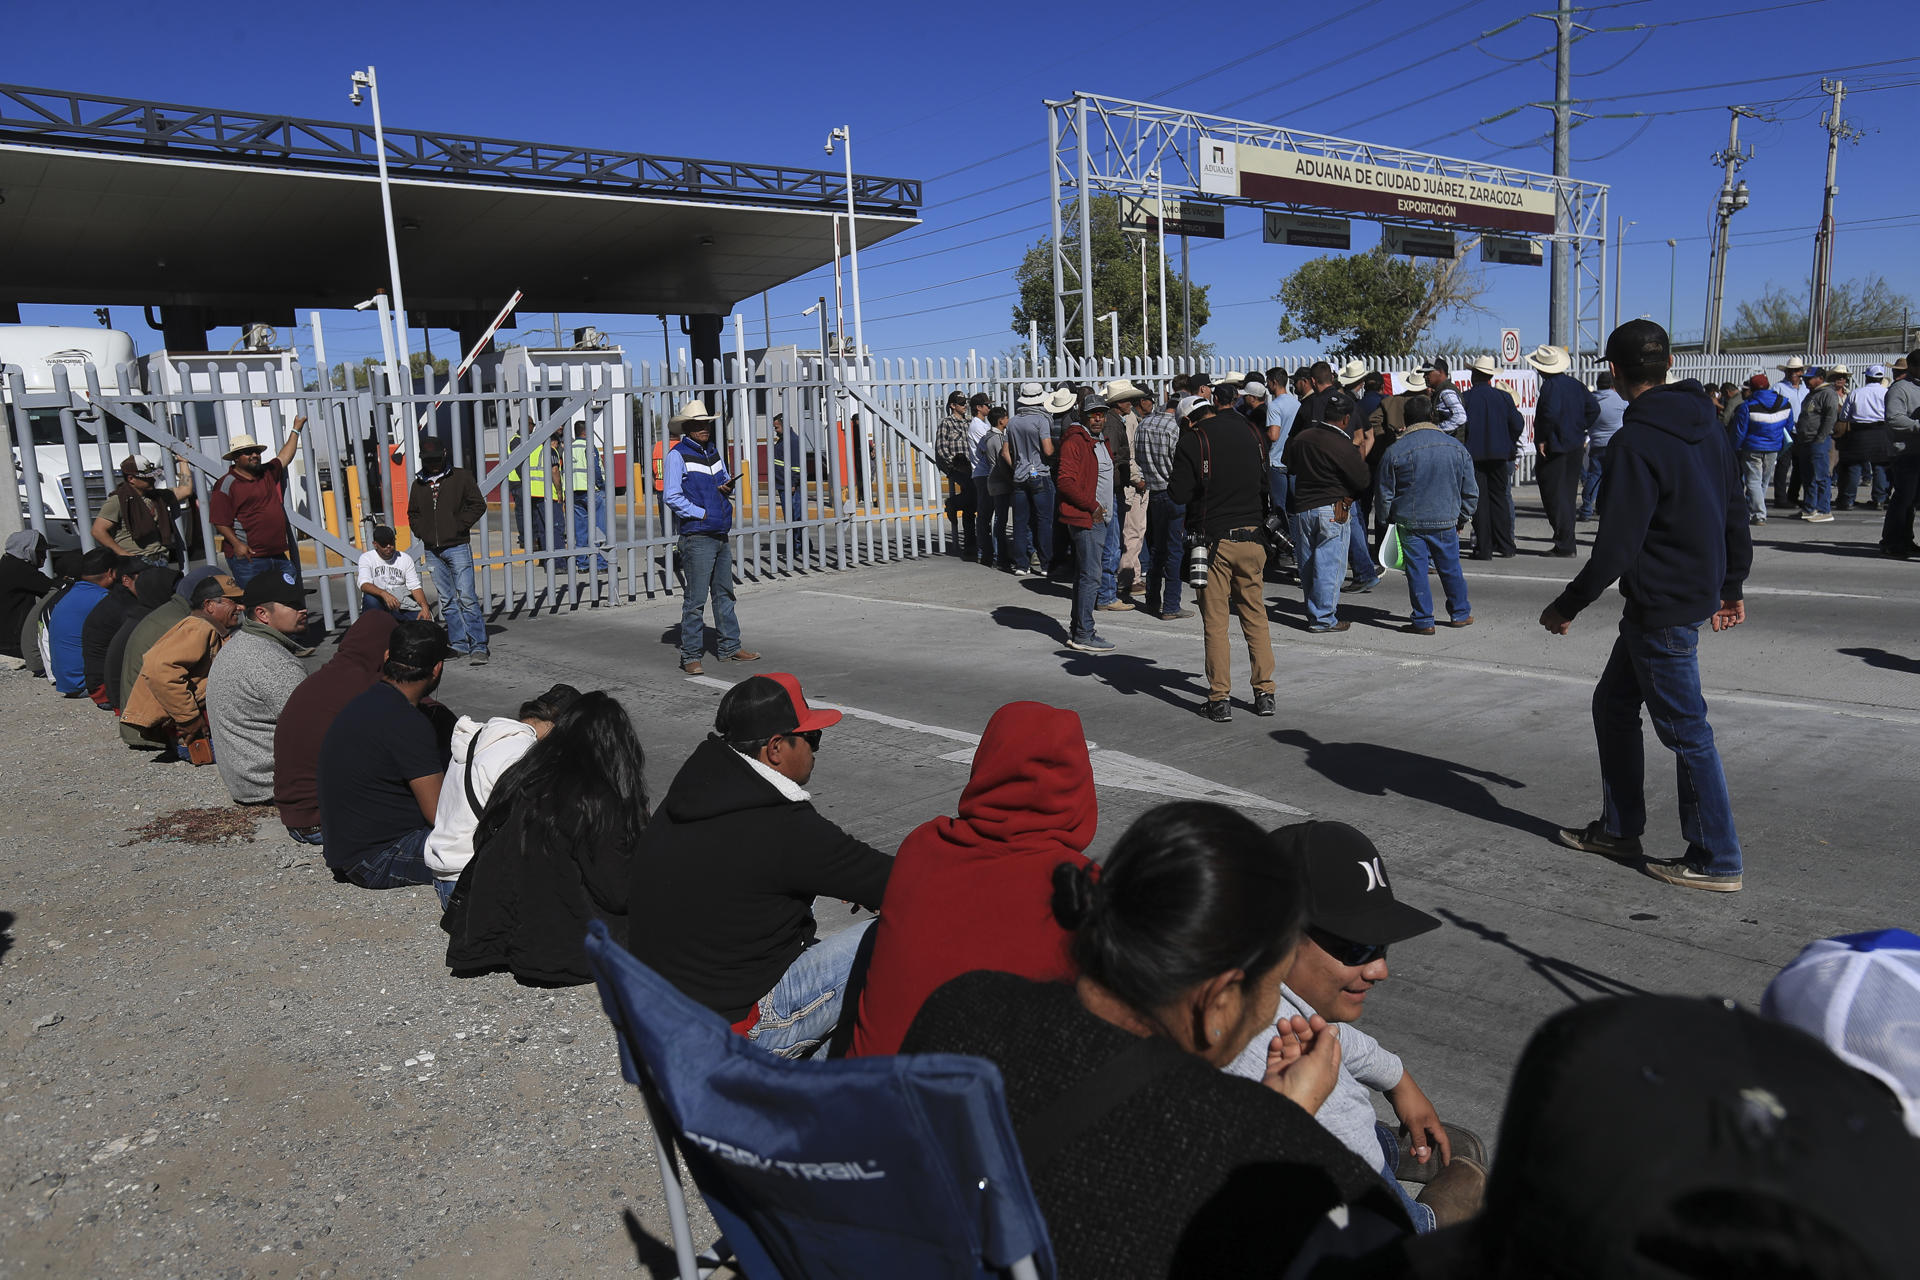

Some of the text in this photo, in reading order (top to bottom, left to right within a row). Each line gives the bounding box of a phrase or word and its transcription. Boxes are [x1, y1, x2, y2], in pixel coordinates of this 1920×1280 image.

[1204, 164, 1234, 175] ADUANAS
[1296, 159, 1523, 207] ADUANA DE CIUDAD JUÁREZ, ZARAGOZA
[1398, 199, 1456, 217] EXPORTACIÓN
[1506, 337, 1514, 351] 20
